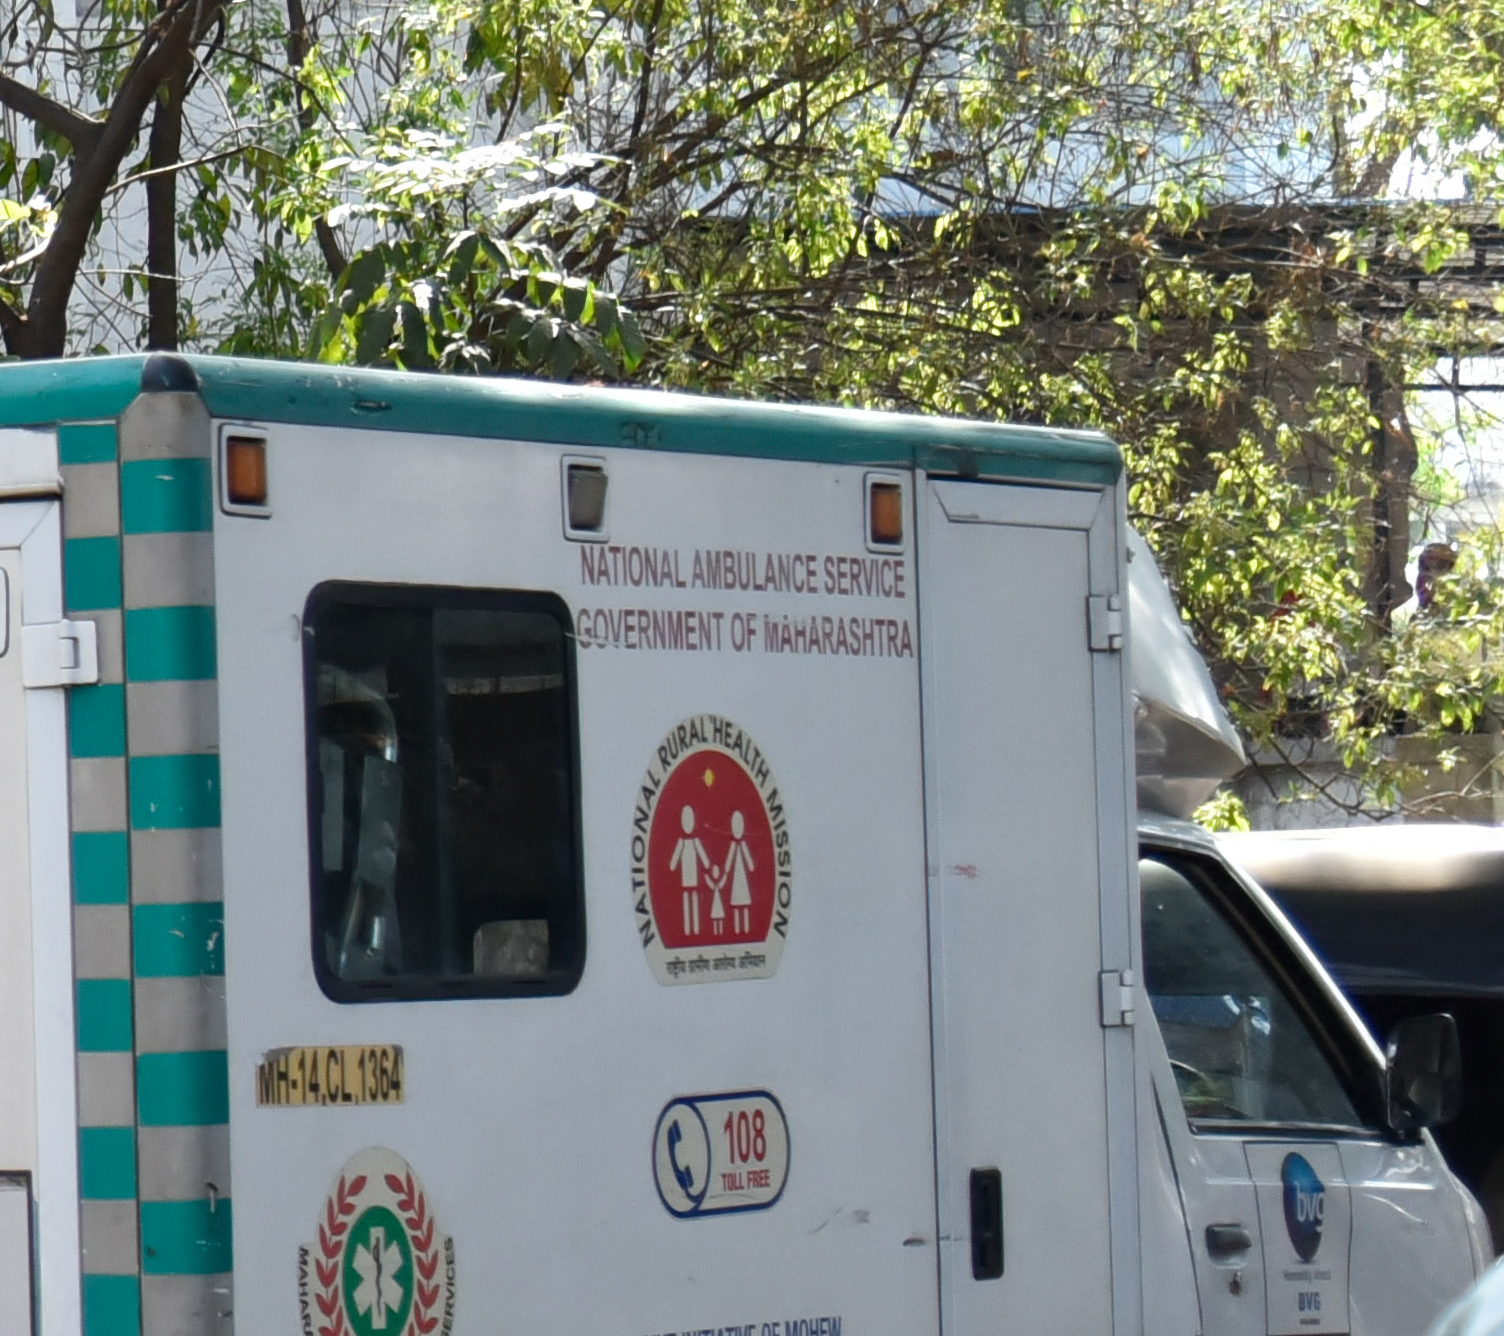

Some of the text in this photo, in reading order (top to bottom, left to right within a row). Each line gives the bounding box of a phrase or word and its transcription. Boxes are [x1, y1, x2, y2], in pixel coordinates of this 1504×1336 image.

[580, 545, 906, 599] NATIONAL AMBULANCE SERVICE
[576, 607, 915, 659] GOVERNMENT OF MAHARASHTRA
[631, 715, 792, 949] NATIONAL RURAL HEALTH MISSION
[724, 1108, 767, 1165] 108
[720, 1168, 771, 1192] TOLL FREE
[1298, 1292, 1322, 1312] BVG
